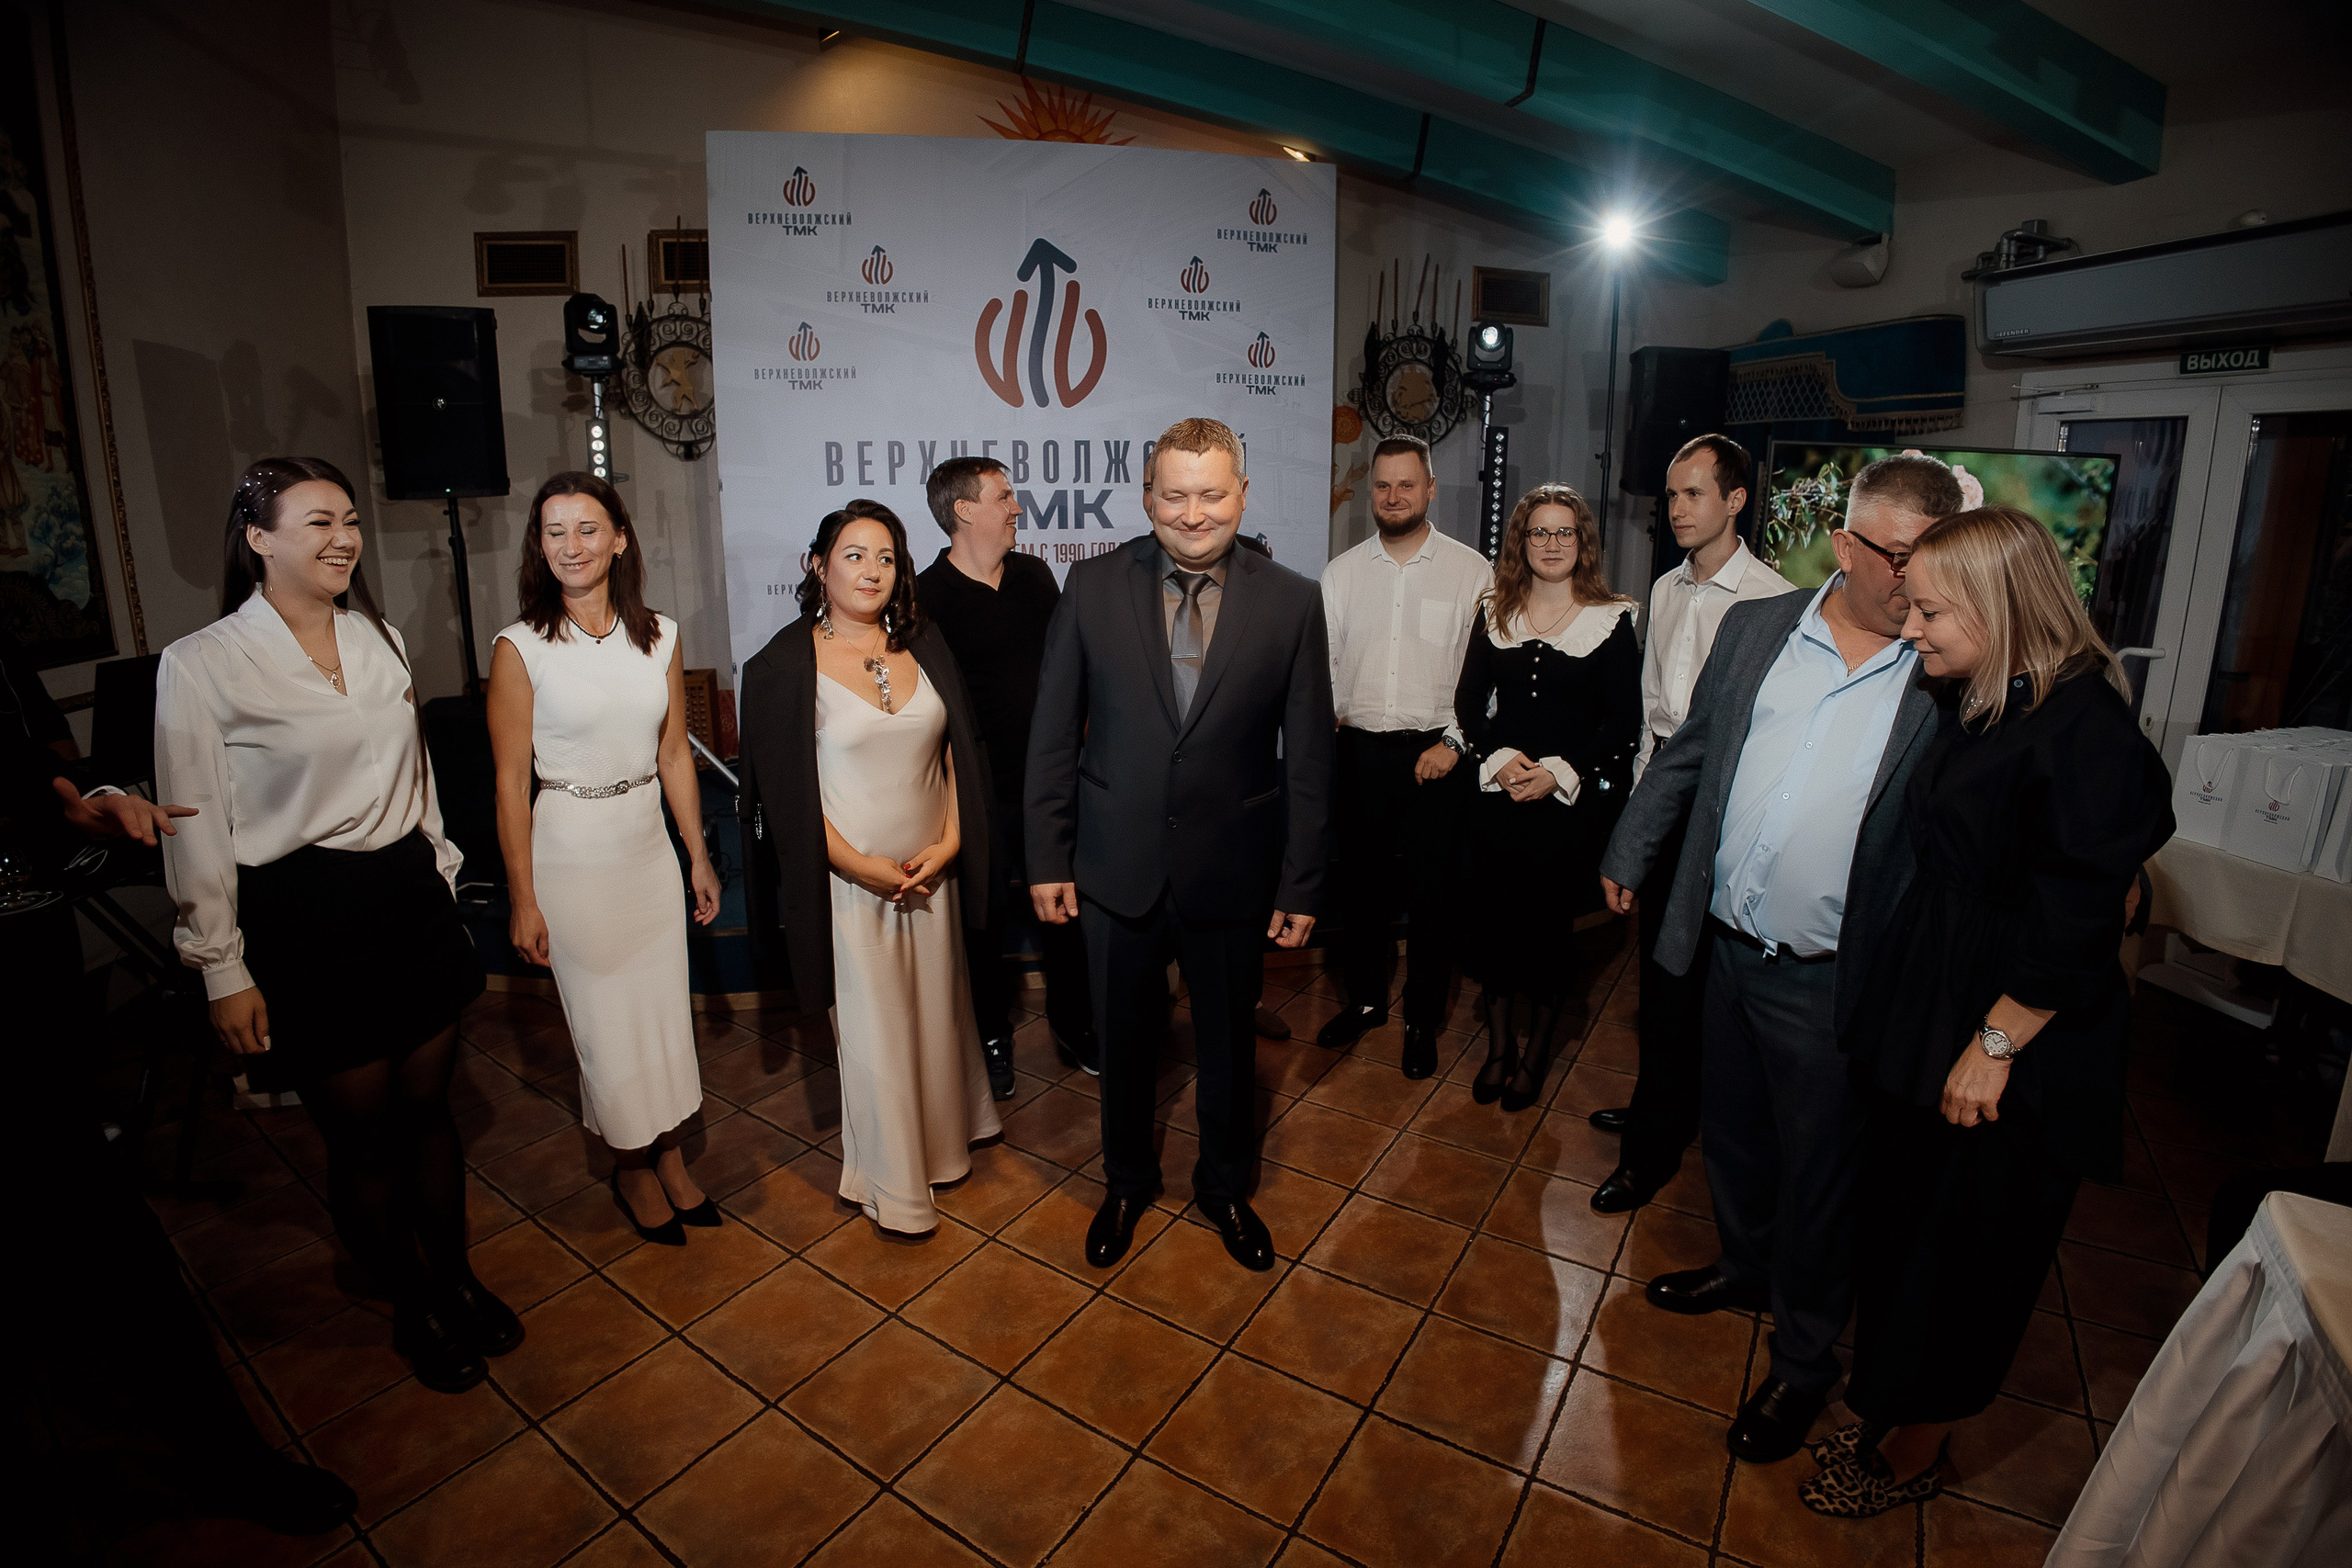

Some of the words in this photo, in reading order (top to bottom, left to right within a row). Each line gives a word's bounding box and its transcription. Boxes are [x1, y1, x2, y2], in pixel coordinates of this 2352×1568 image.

[747, 212, 853, 225] ВЕРХНЕВОЛЖСКИЙ
[782, 225, 818, 236] ТМК
[1216, 228, 1308, 245] ВЕРХНЕВОЛЖСКИЙ
[1247, 242, 1278, 253] ТМК
[826, 290, 929, 303] ВЕРХНЕВОЛЖСКИЙ
[861, 303, 896, 313] ТМК
[1148, 298, 1241, 312] ВЕРХНЕВОЛЖСКИЙ
[1179, 310, 1210, 321] ТМК
[1995, 329, 2030, 337] DEFENDER
[2187, 349, 2260, 371] ВЫХОД
[753, 367, 856, 379] ВЕРХНЕВОЛЖСКИЙ
[787, 379, 823, 390] ТМК
[1216, 373, 1306, 387] ВЕРХНЕВОЛЖСКИЙ
[1246, 385, 1276, 395] ТМК
[1014, 489, 1114, 530] МК
[1053, 543, 1086, 564] 1990
